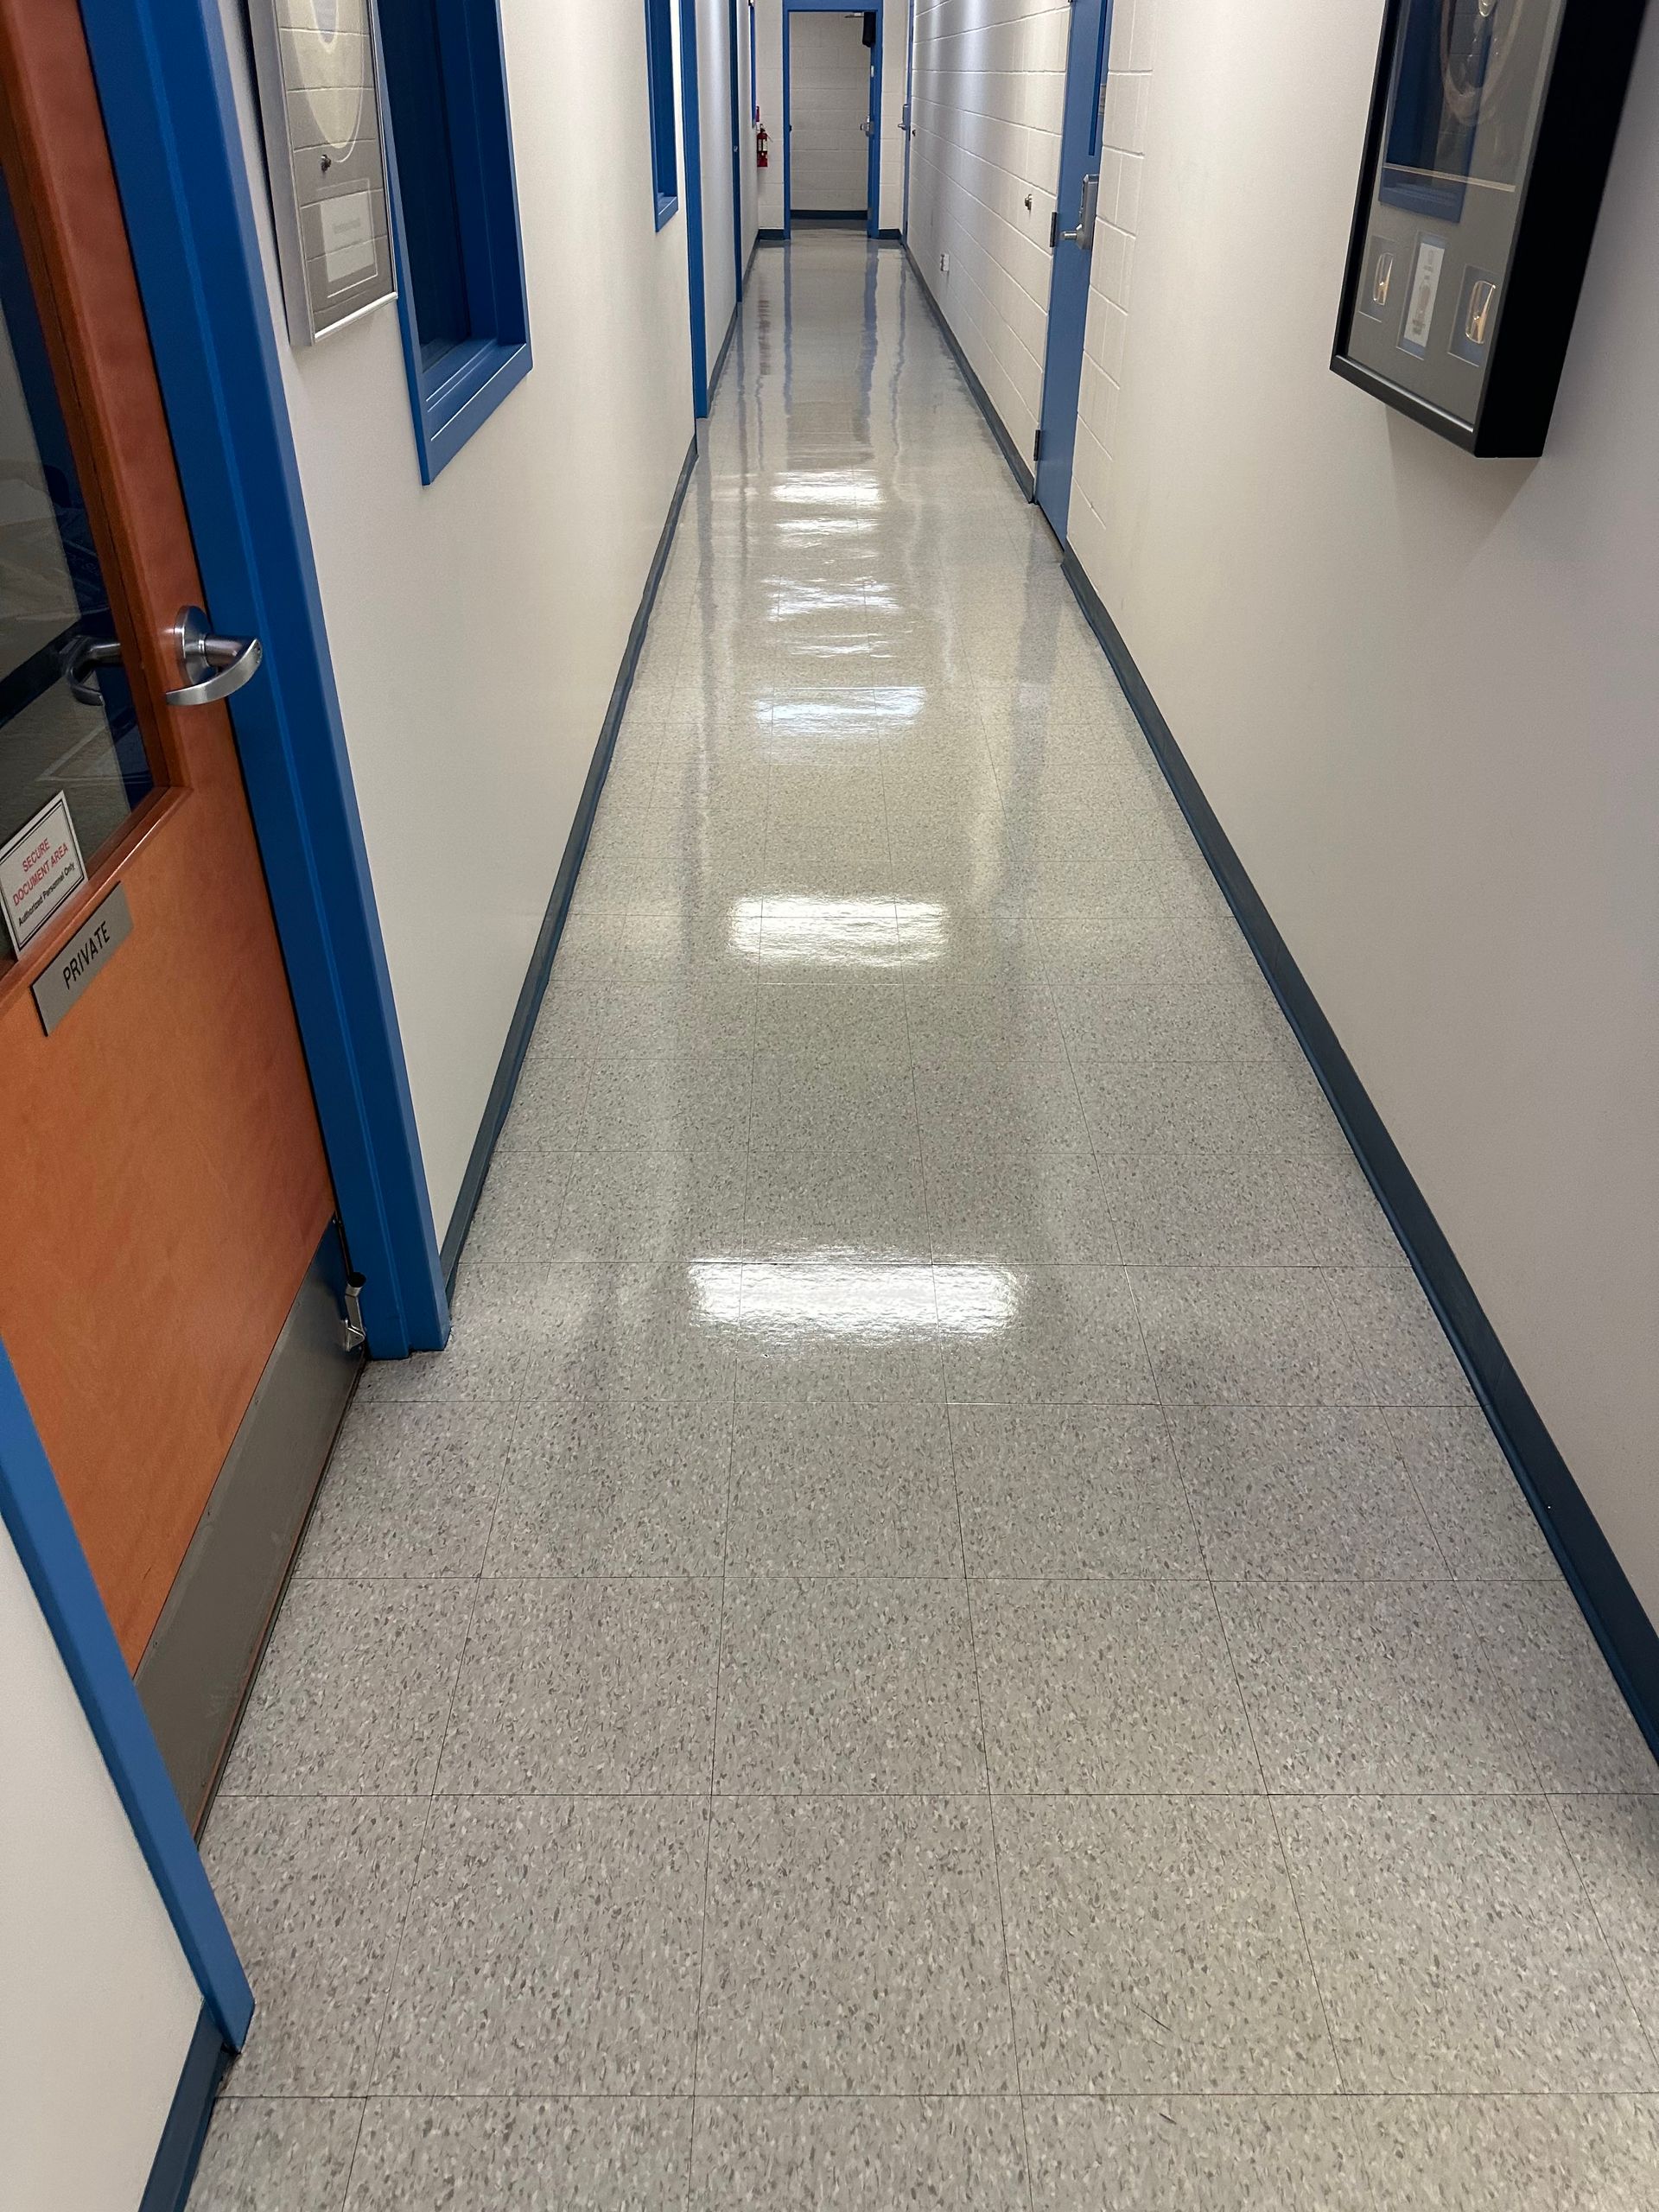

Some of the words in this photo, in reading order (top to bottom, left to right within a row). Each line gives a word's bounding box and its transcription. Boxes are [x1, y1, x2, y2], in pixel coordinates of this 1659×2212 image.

[12, 860, 50, 906] DOCUMENT
[51, 842, 69, 868] AREA
[22, 837, 50, 872] SECURE
[18, 895, 43, 926] Authorized
[42, 871, 65, 899] Personnel
[63, 861, 75, 876] Only
[63, 920, 111, 990] PRIVATE
